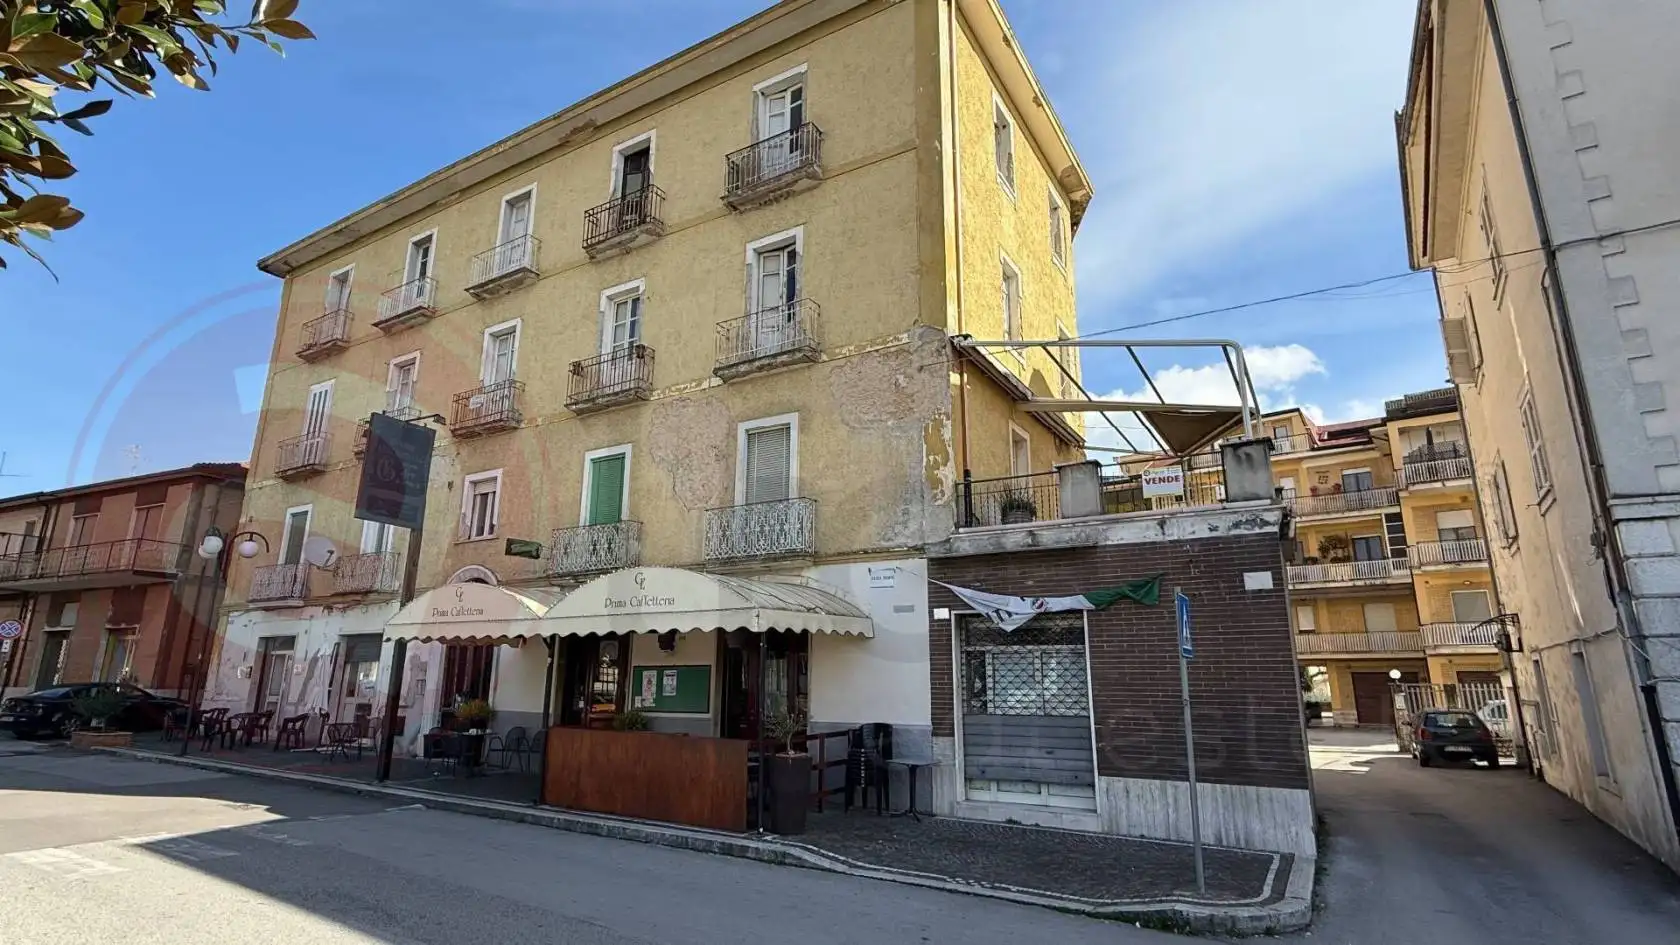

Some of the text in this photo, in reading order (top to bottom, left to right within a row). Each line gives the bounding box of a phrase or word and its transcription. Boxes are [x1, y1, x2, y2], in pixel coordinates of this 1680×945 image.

[1144, 475, 1181, 485] VENDE
[604, 594, 675, 609] Prima Caffetteria
